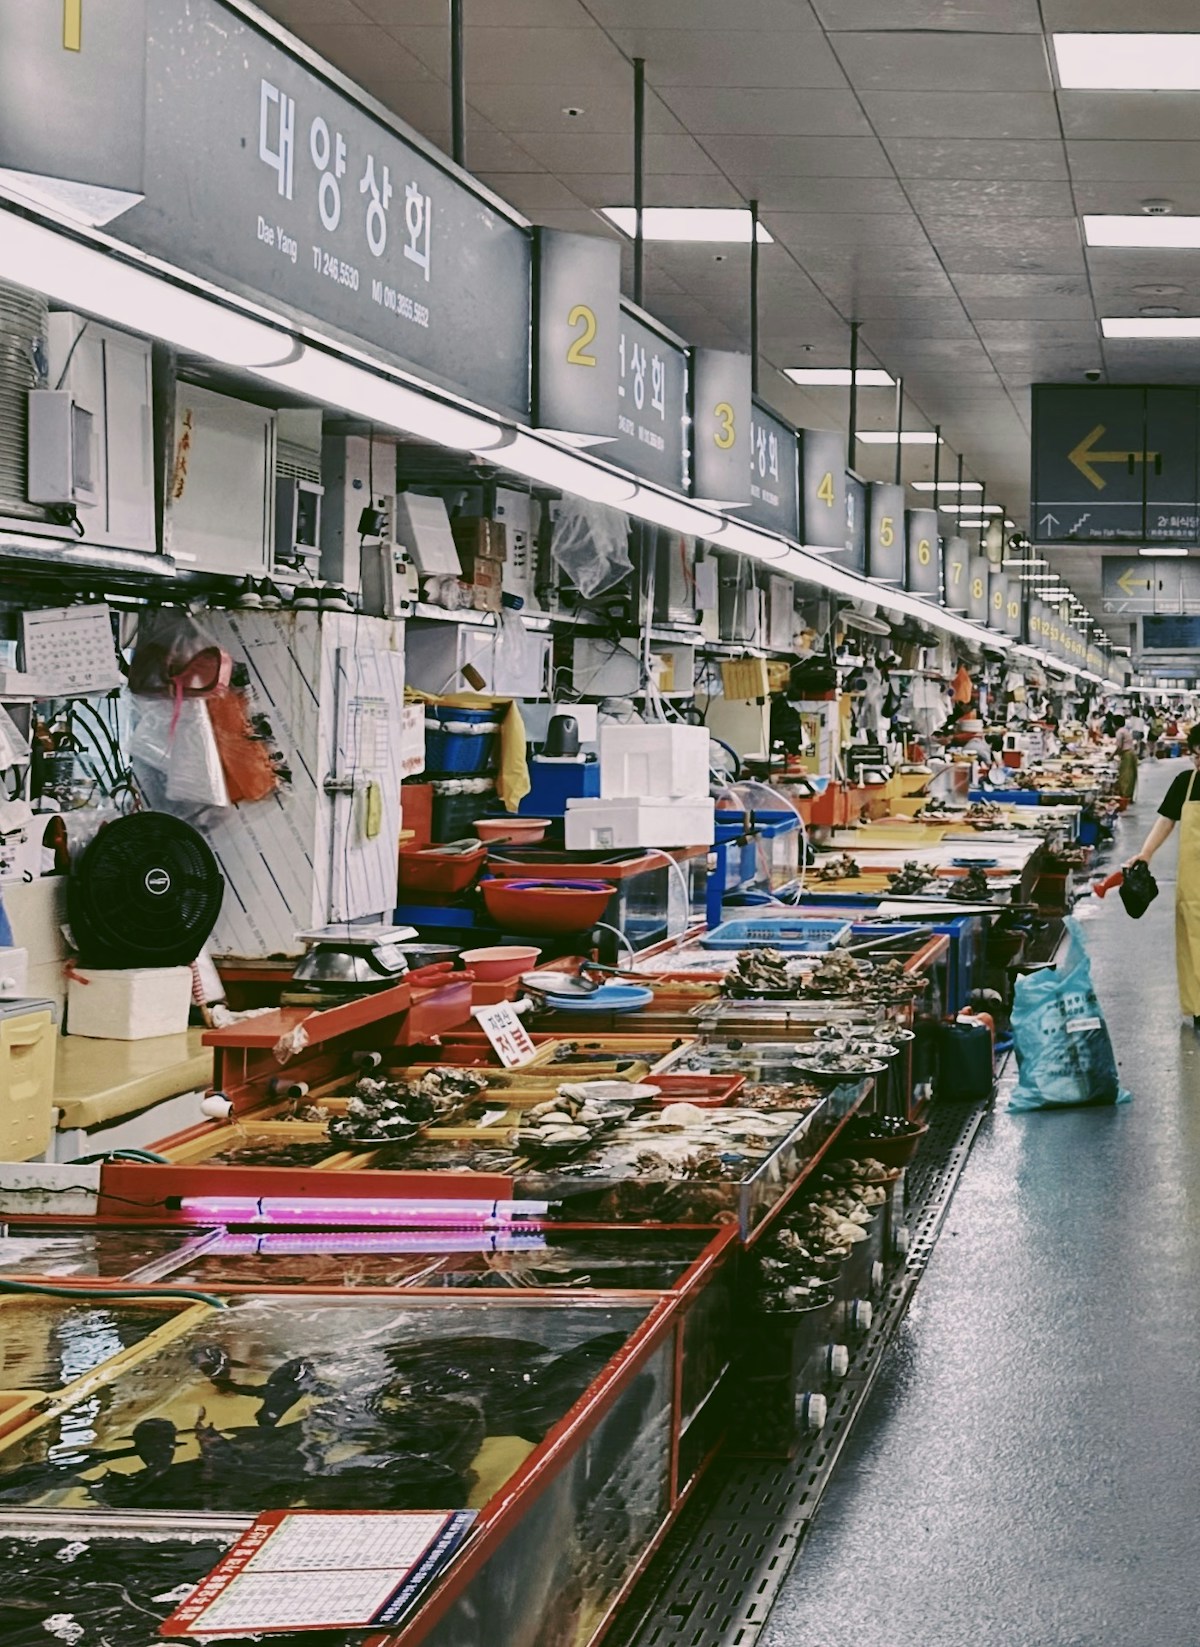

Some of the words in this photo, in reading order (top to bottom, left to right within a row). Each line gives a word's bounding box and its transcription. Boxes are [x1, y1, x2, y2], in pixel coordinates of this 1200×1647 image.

[259, 78, 431, 281] 대양상회
[257, 215, 274, 246] Dae
[276, 226, 298, 264] Yang
[566, 304, 597, 367] 2
[713, 402, 736, 449] 3
[750, 421, 779, 482] 상회
[817, 472, 835, 508] 4
[880, 517, 894, 547] 5
[918, 539, 931, 565] 6
[952, 562, 962, 585] 7
[972, 579, 983, 599] 8
[994, 592, 1003, 610] 9
[1006, 602, 1019, 619] 10
[496, 1027, 534, 1066] 전복
